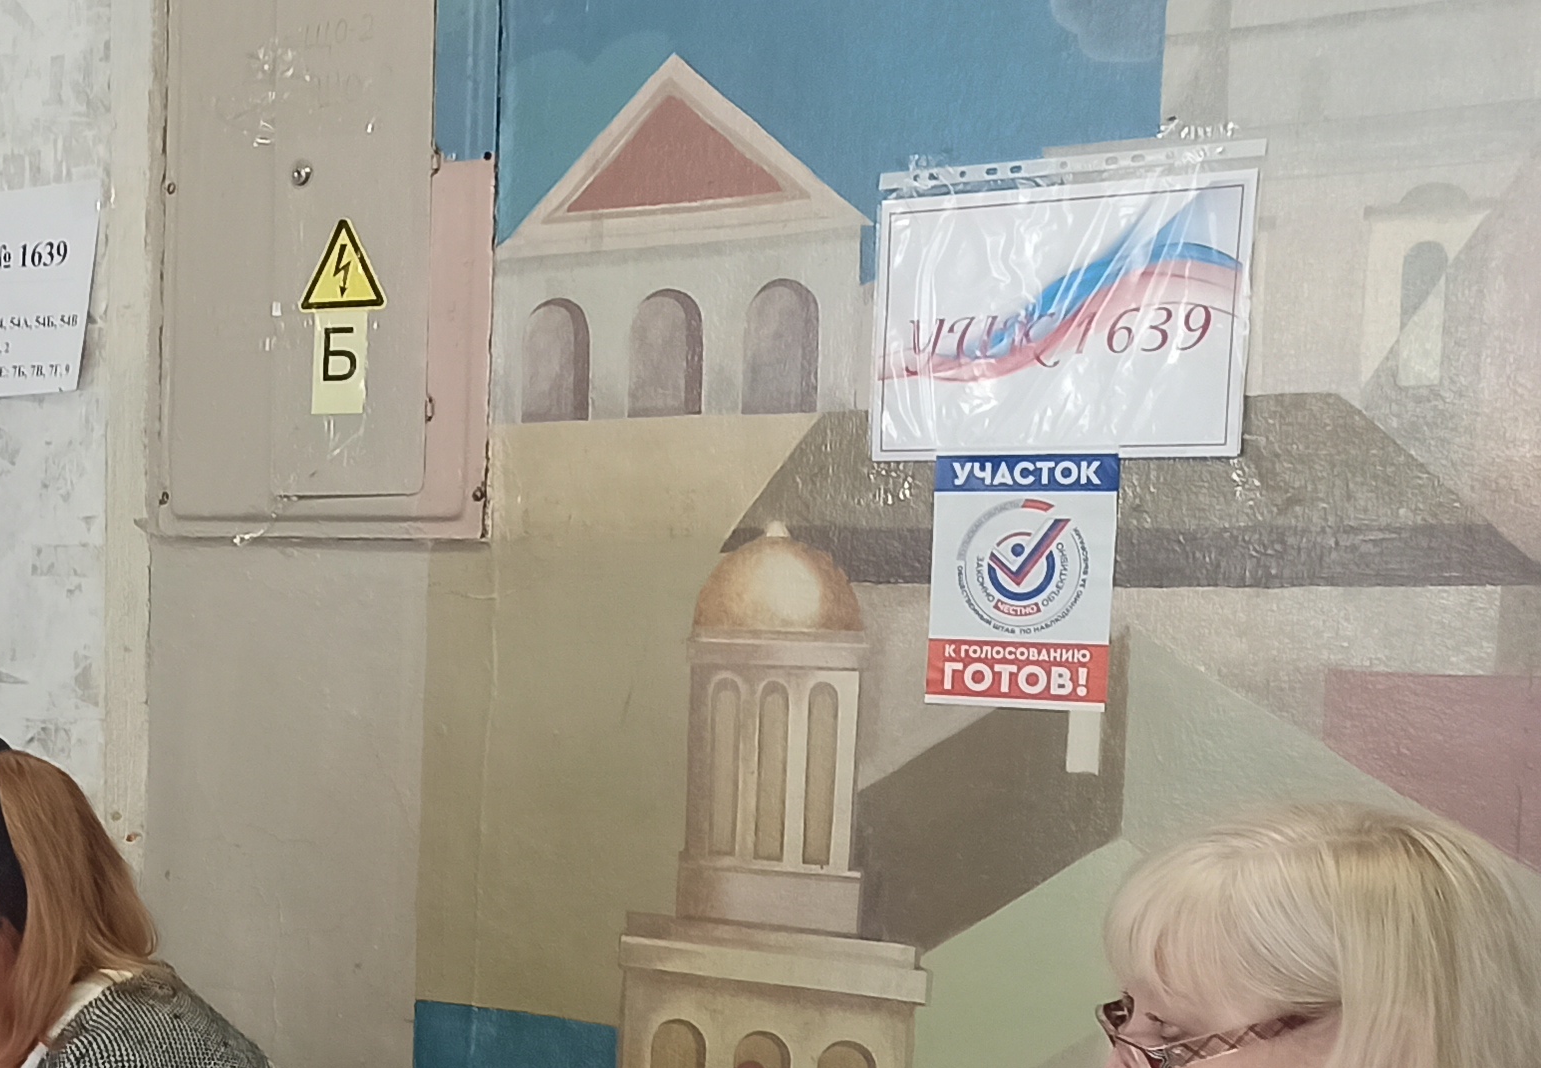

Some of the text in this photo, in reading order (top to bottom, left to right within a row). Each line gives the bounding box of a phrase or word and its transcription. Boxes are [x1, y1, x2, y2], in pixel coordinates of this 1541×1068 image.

[19, 240, 68, 268] 1639
[1074, 304, 1213, 355] 1639
[322, 326, 357, 382] Б
[952, 460, 1102, 486] УЧАСТОК
[996, 600, 1038, 616] ЧЕСТНО
[945, 644, 1091, 663] К ГОЛОСОВАНИЮ
[943, 662, 1089, 697] ГОТОВ!
